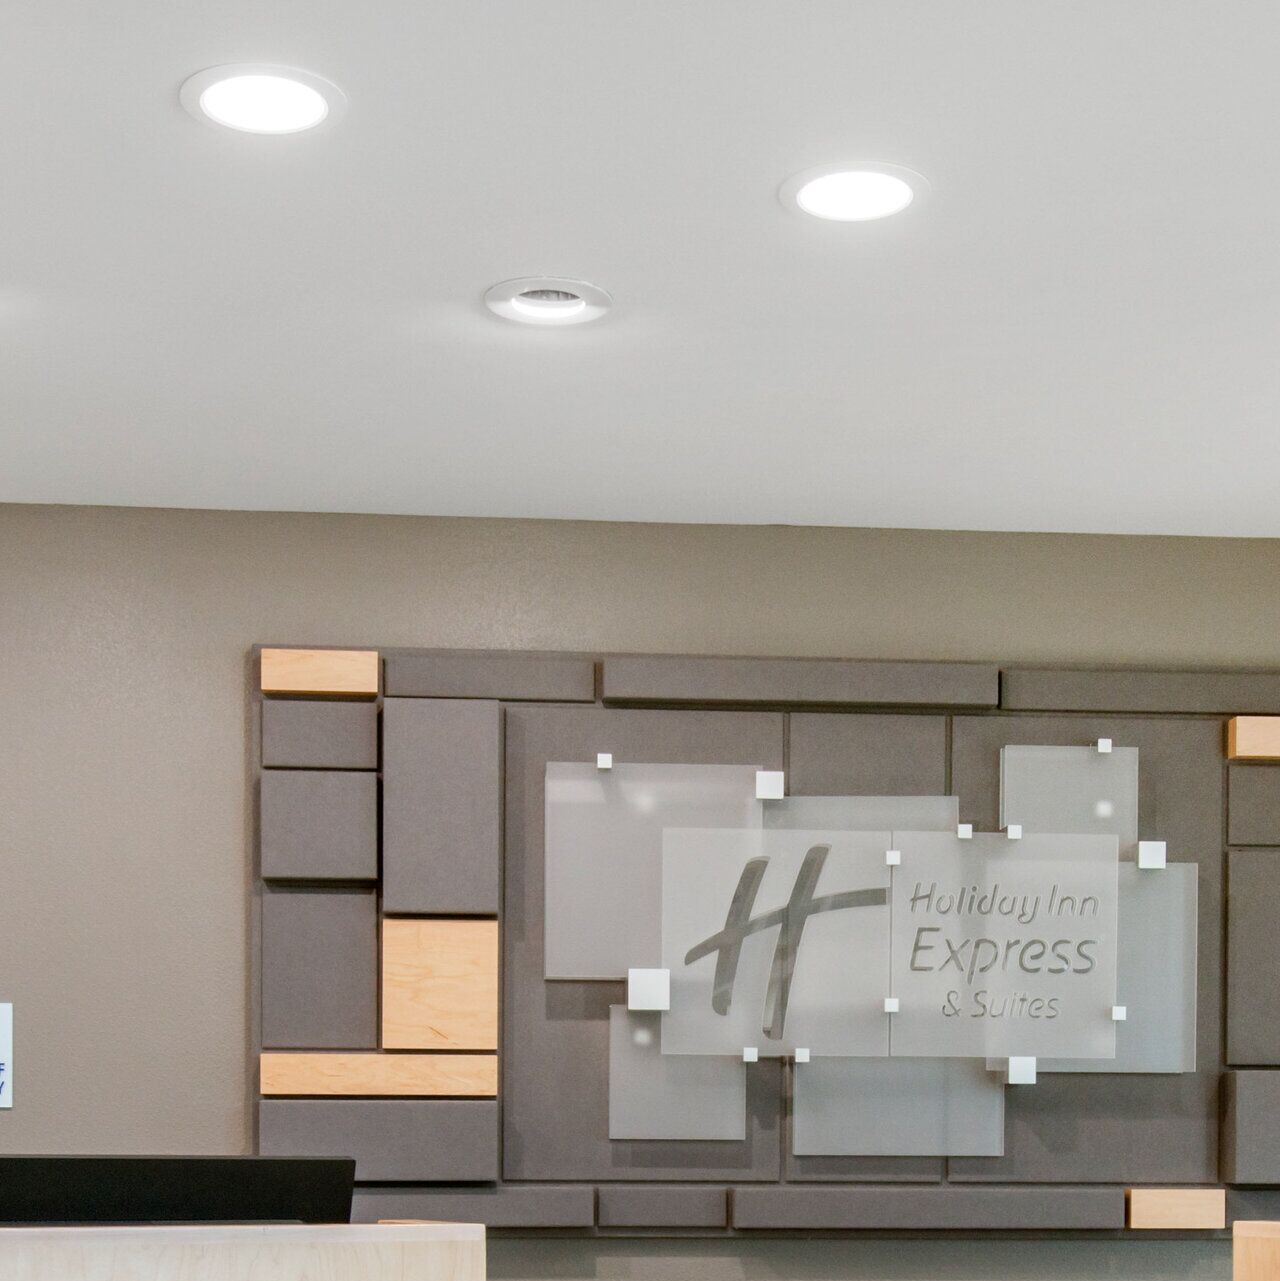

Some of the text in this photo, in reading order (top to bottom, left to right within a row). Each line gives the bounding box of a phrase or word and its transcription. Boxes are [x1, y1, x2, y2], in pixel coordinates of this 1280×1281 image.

[910, 882, 1099, 924] Holiday Inn
[909, 926, 1098, 985] Express
[942, 990, 1060, 1019] & Suites
